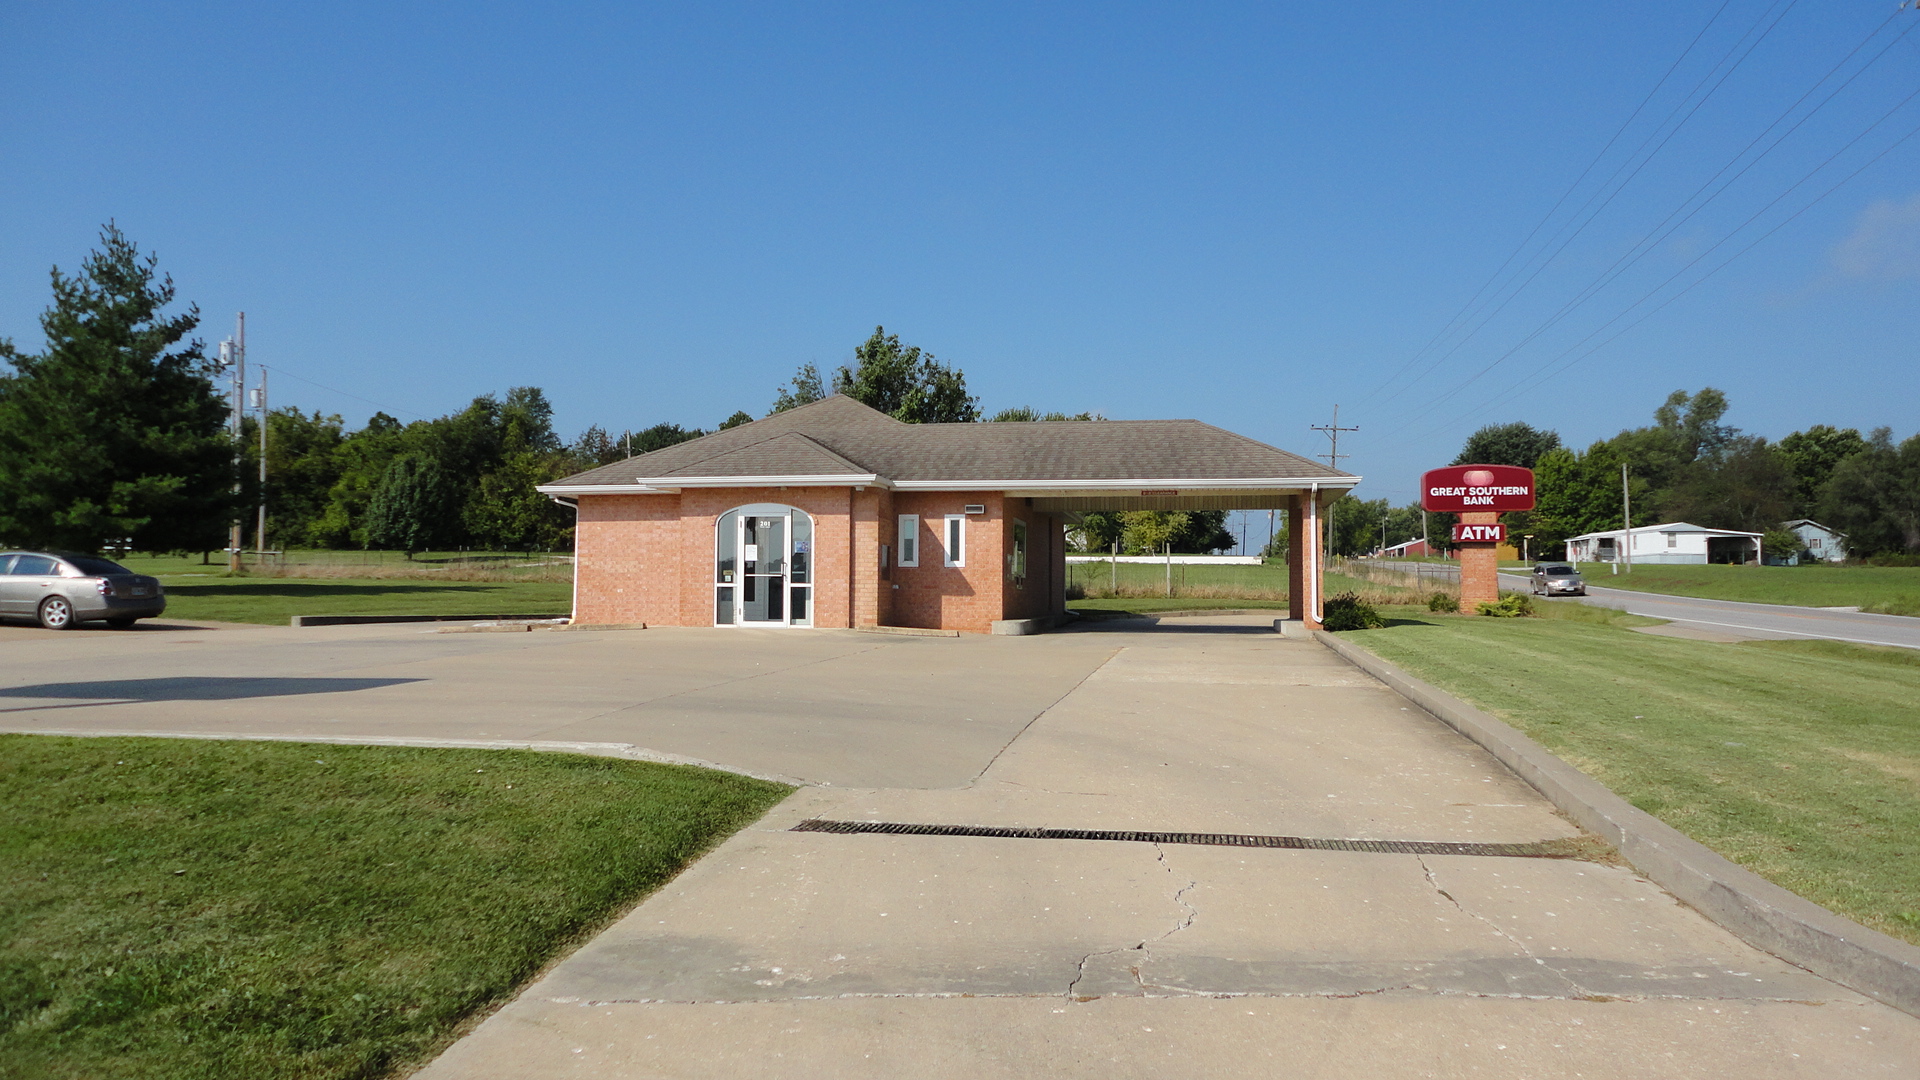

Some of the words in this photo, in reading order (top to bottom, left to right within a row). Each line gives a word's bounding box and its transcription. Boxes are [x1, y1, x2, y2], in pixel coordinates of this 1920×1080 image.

[1430, 487, 1467, 496] GREAT
[1469, 486, 1528, 496] SOUTHERN
[1463, 496, 1494, 505] BANK
[1460, 526, 1500, 540] ATM
